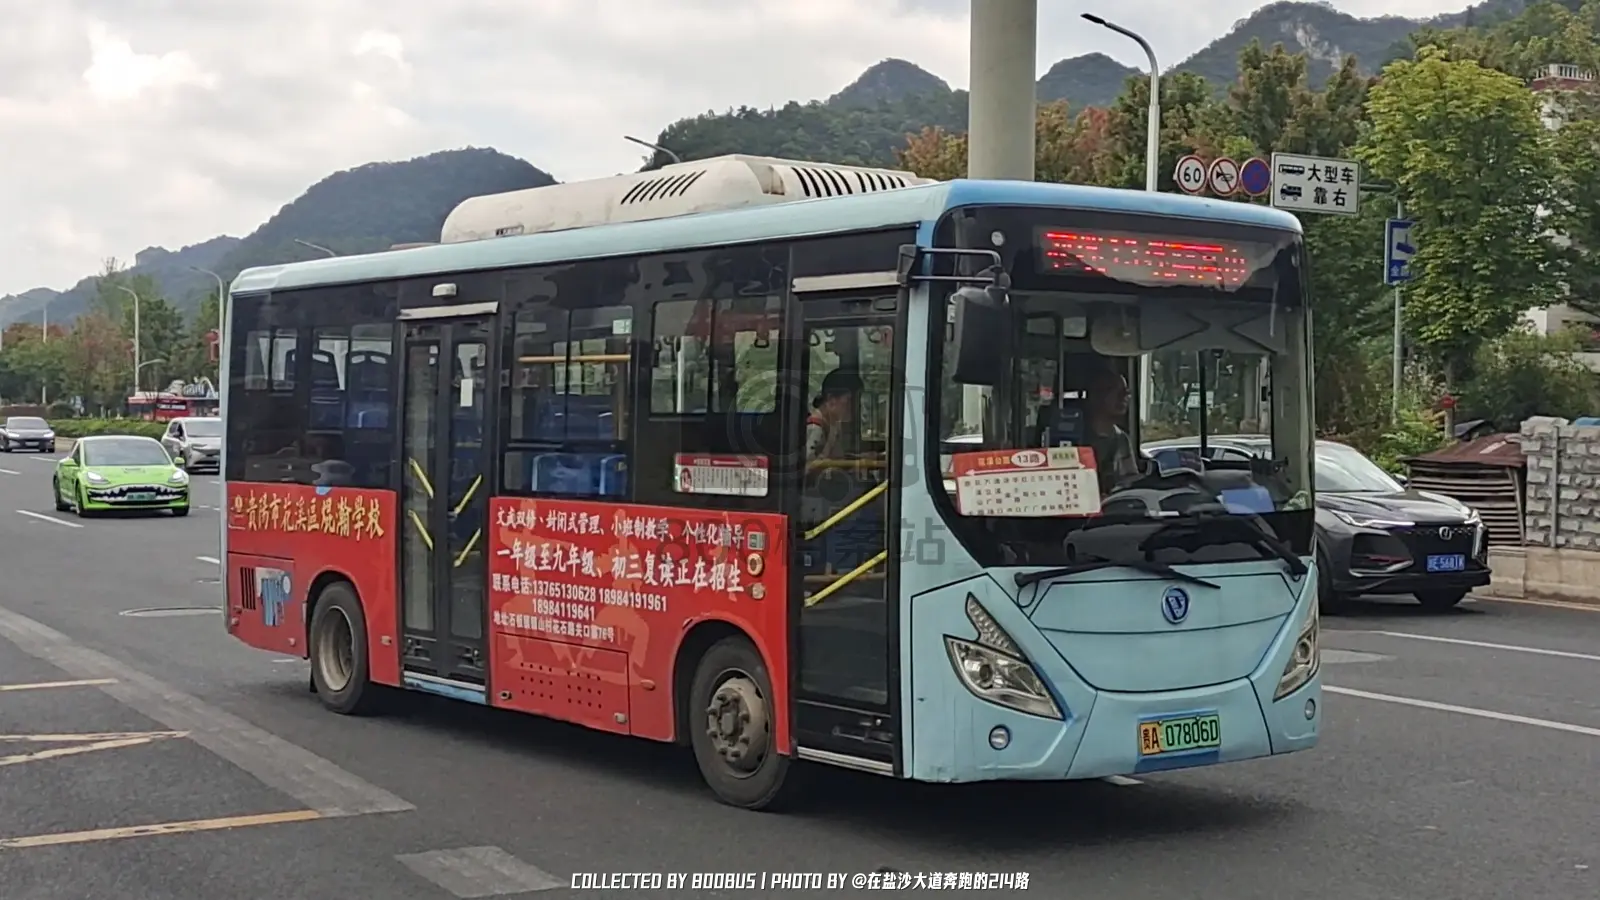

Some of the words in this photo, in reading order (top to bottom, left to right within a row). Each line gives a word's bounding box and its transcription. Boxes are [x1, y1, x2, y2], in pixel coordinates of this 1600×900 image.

[1183, 166, 1201, 184] 60
[1307, 163, 1354, 186] 大型车
[1313, 186, 1347, 207] 靠右
[532, 598, 595, 621] 18984119641
[599, 587, 668, 612] 18984191961
